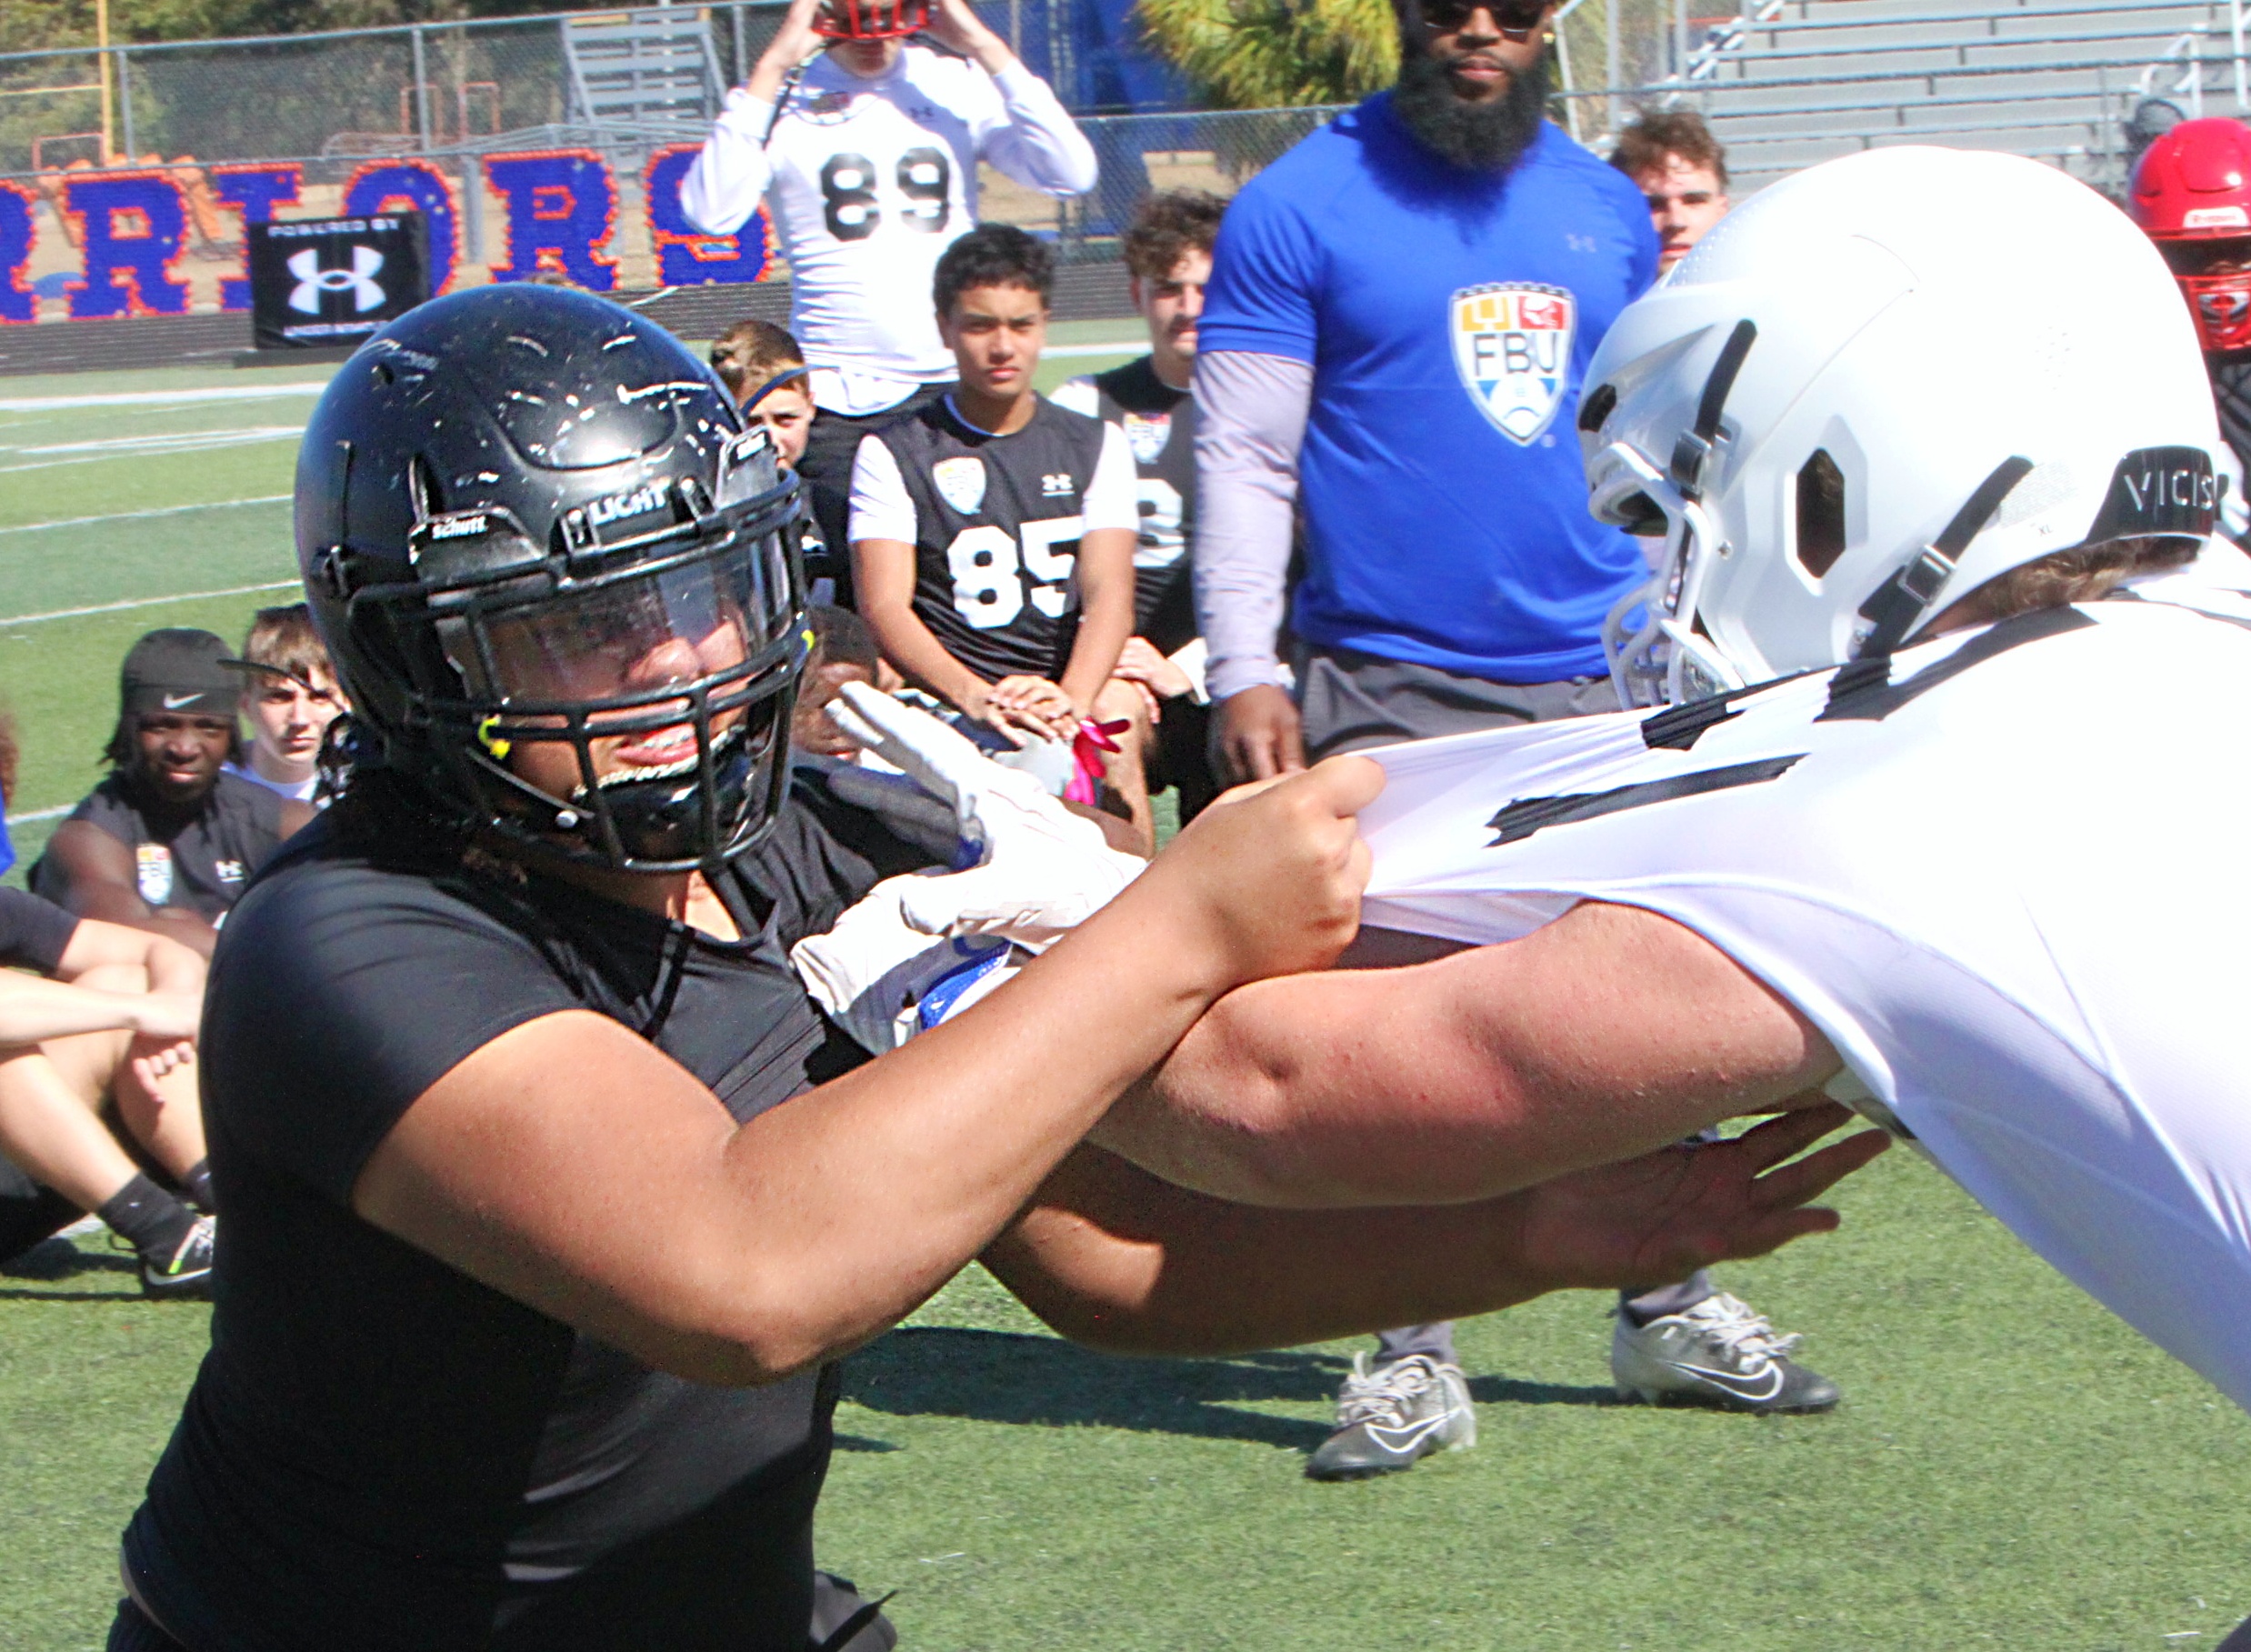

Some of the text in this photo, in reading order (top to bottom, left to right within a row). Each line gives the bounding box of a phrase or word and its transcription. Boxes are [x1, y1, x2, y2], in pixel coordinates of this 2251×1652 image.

[820, 146, 950, 242] 89
[1473, 331, 1557, 377] FBU
[2124, 469, 2213, 512] VICIS
[947, 516, 1084, 628] 85
